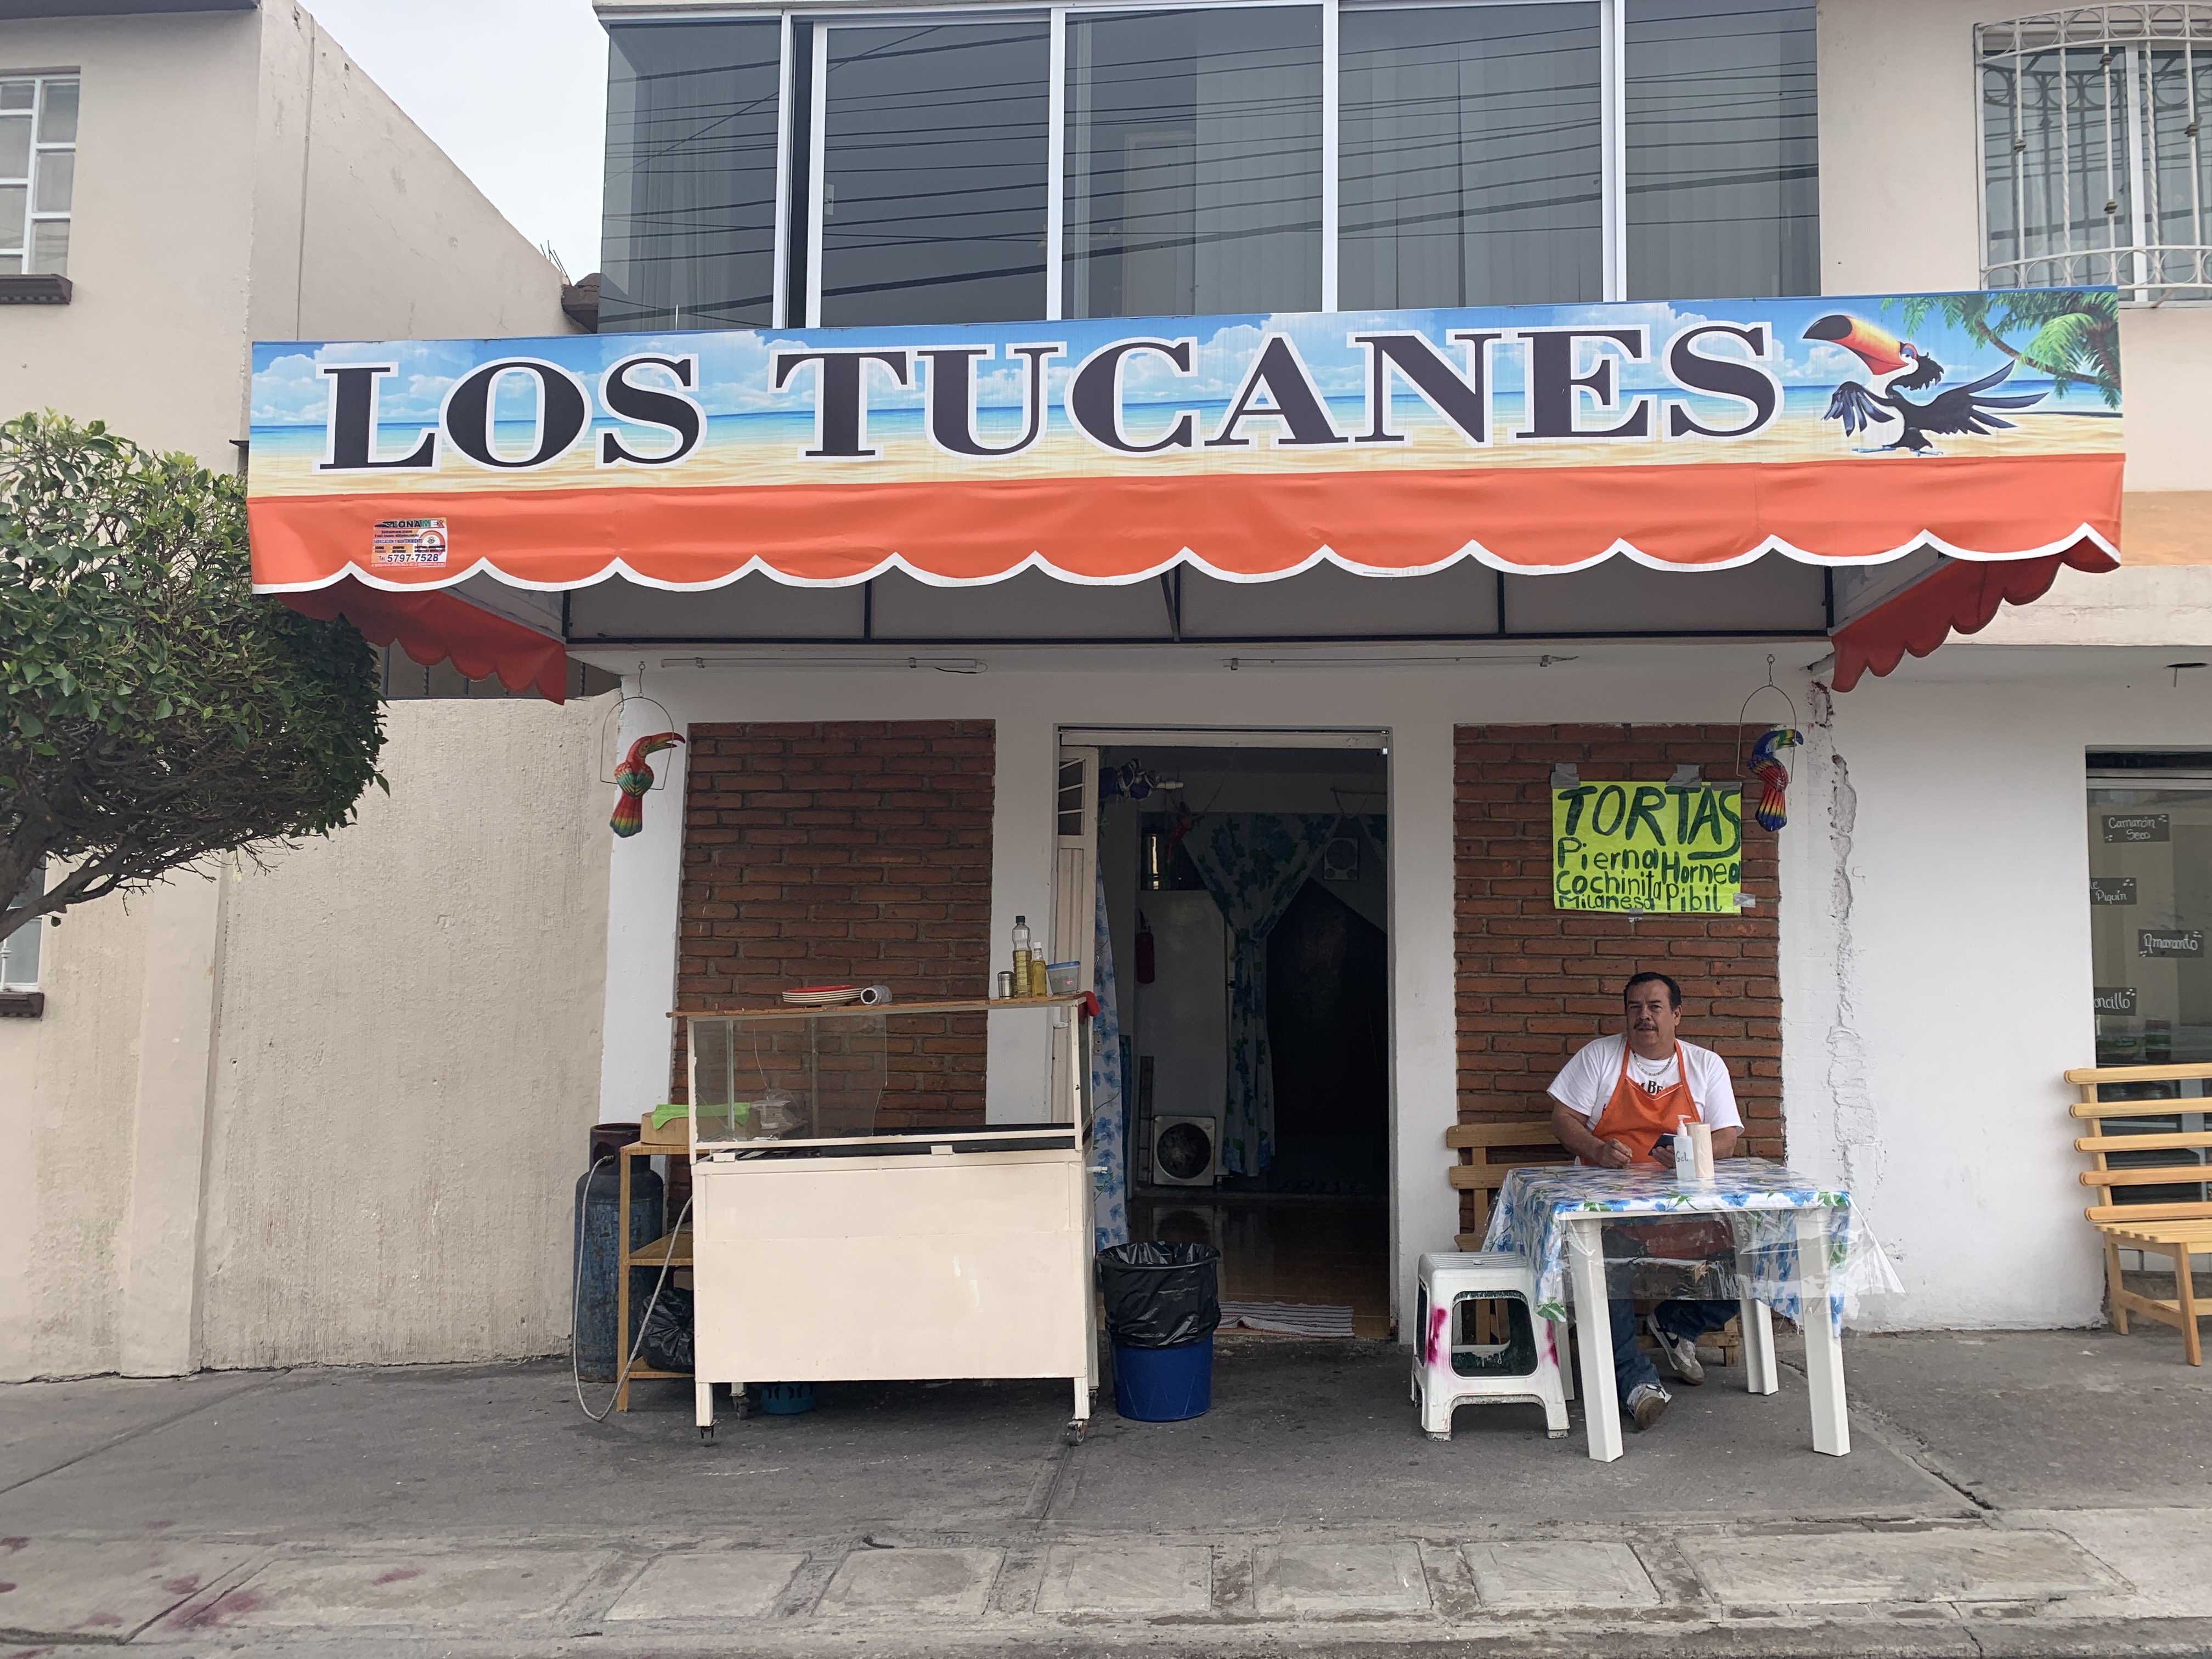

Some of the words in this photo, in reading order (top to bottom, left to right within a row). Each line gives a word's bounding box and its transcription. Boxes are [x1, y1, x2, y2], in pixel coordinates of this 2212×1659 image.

[317, 356, 701, 472] LOS
[772, 324, 1780, 460] TUCANES
[392, 520, 444, 528] LONAMEX
[387, 554, 439, 562] 5797-7528
[1557, 785, 1741, 860] TORTAS
[2108, 816, 2157, 828] Camarón
[2126, 829, 2151, 840] Seco
[1557, 837, 1660, 871] Pierna
[1556, 870, 1662, 901] Cochinita
[1666, 883, 1723, 912] Pibil
[1558, 894, 1655, 911] Milanesa
[2143, 933, 2198, 954] Amaranto
[1676, 1150, 1689, 1163] Gel
